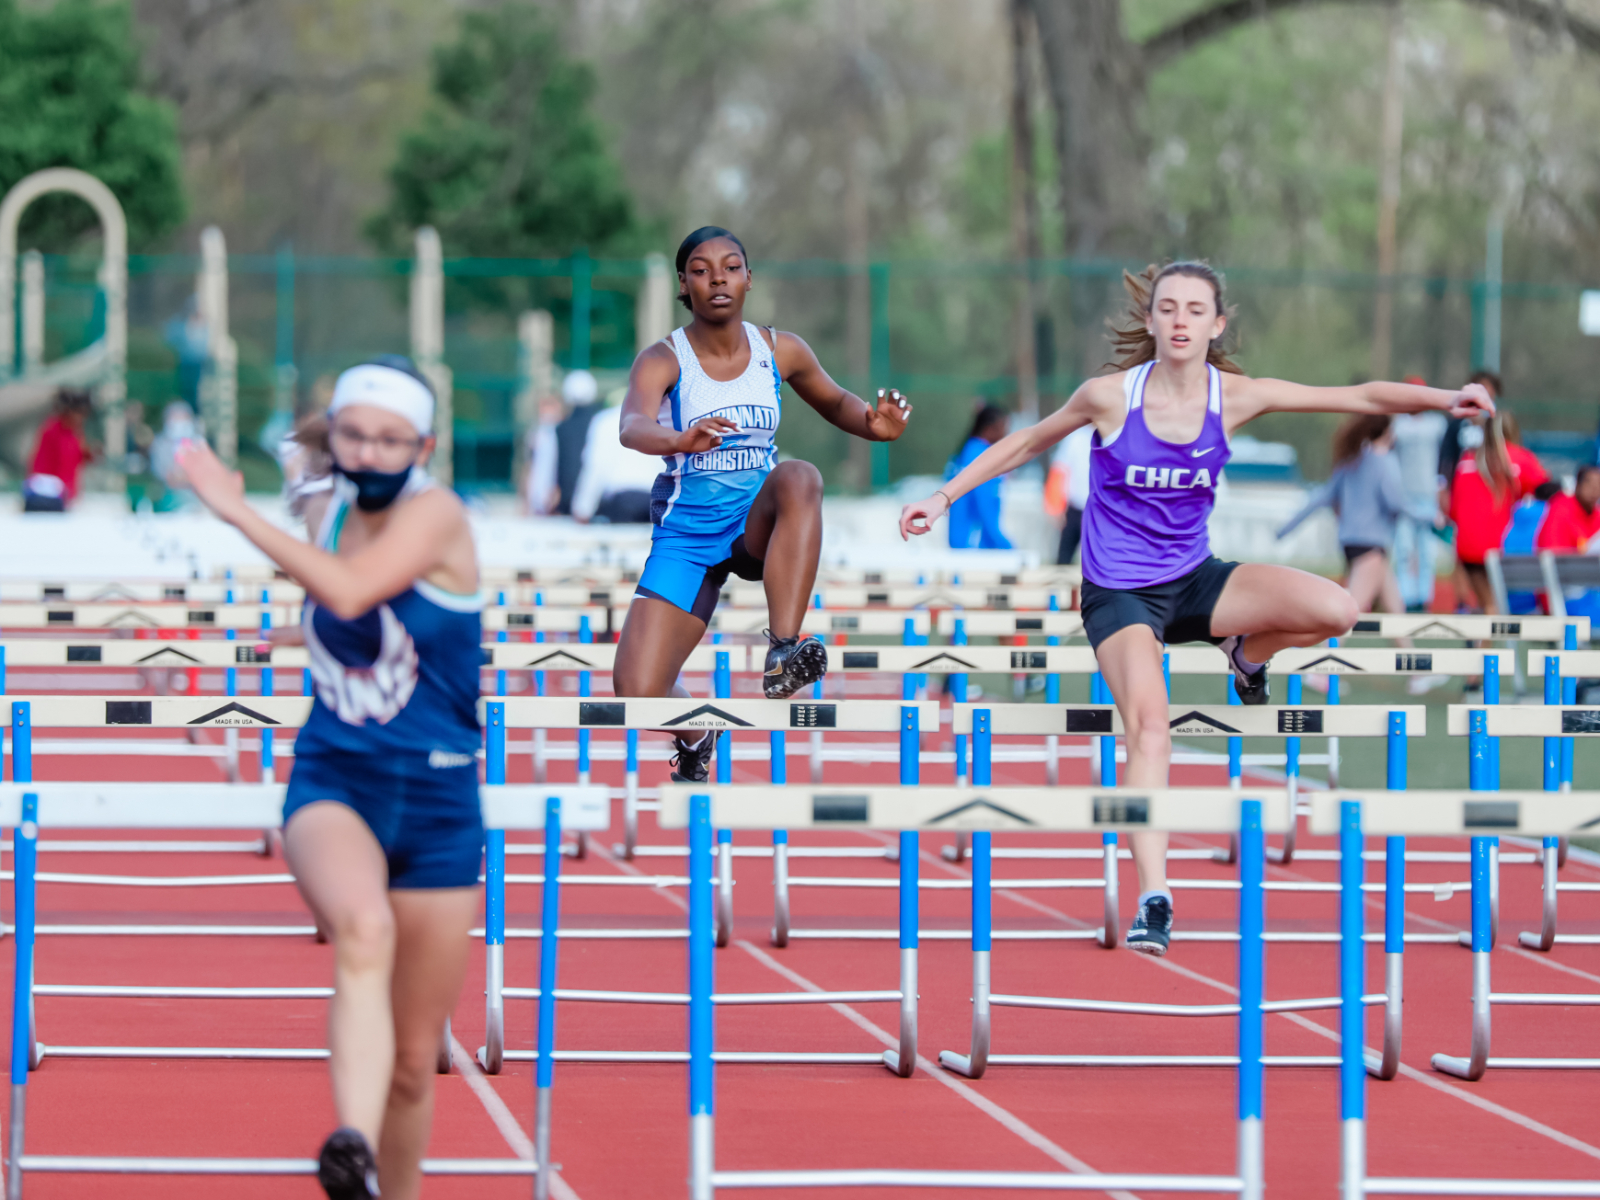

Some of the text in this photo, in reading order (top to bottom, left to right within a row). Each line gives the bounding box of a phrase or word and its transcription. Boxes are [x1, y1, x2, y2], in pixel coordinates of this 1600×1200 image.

[688, 406, 776, 430] INNATI
[693, 447, 765, 471] CHRISTIAN
[1125, 464, 1212, 489] CHCA
